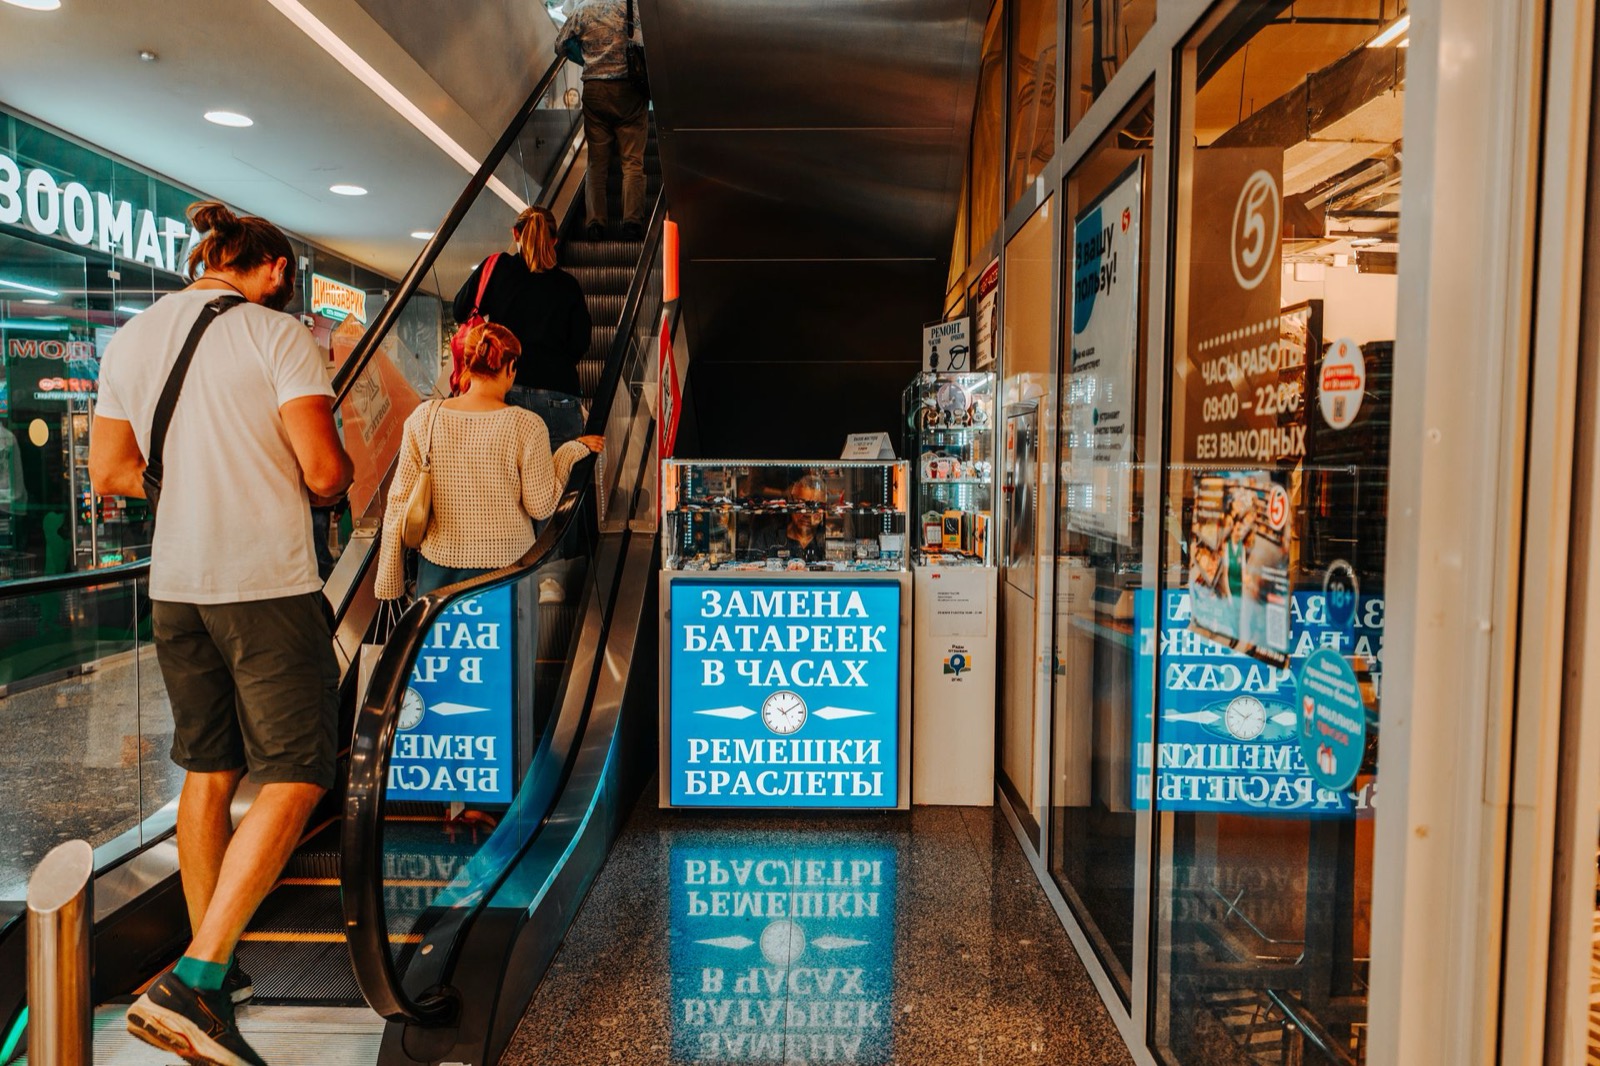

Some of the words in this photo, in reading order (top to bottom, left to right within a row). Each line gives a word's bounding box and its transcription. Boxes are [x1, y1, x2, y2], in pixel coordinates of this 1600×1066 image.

[1083, 223, 1114, 266] вашу
[1076, 252, 1117, 302] пользу!
[313, 278, 366, 320] ДИНОЗАВРИК
[931, 322, 961, 339] РЕМОНТ
[1202, 353, 1238, 386] ЧАСЫ
[1203, 392, 1239, 423] 09:00
[1255, 381, 1299, 416] 22:00
[1197, 432, 1218, 459] БЕЗ
[1220, 424, 1307, 462] ВЫХОДНЫХ
[700, 590, 870, 618] ЗАМЕНА
[683, 625, 887, 652] БАТАРЕЕК
[701, 659, 726, 687] В
[735, 659, 869, 687] ЧАСАХ
[687, 738, 882, 765] РЕМЕШКИ
[684, 770, 884, 797] БРАСЛЕТЫ
